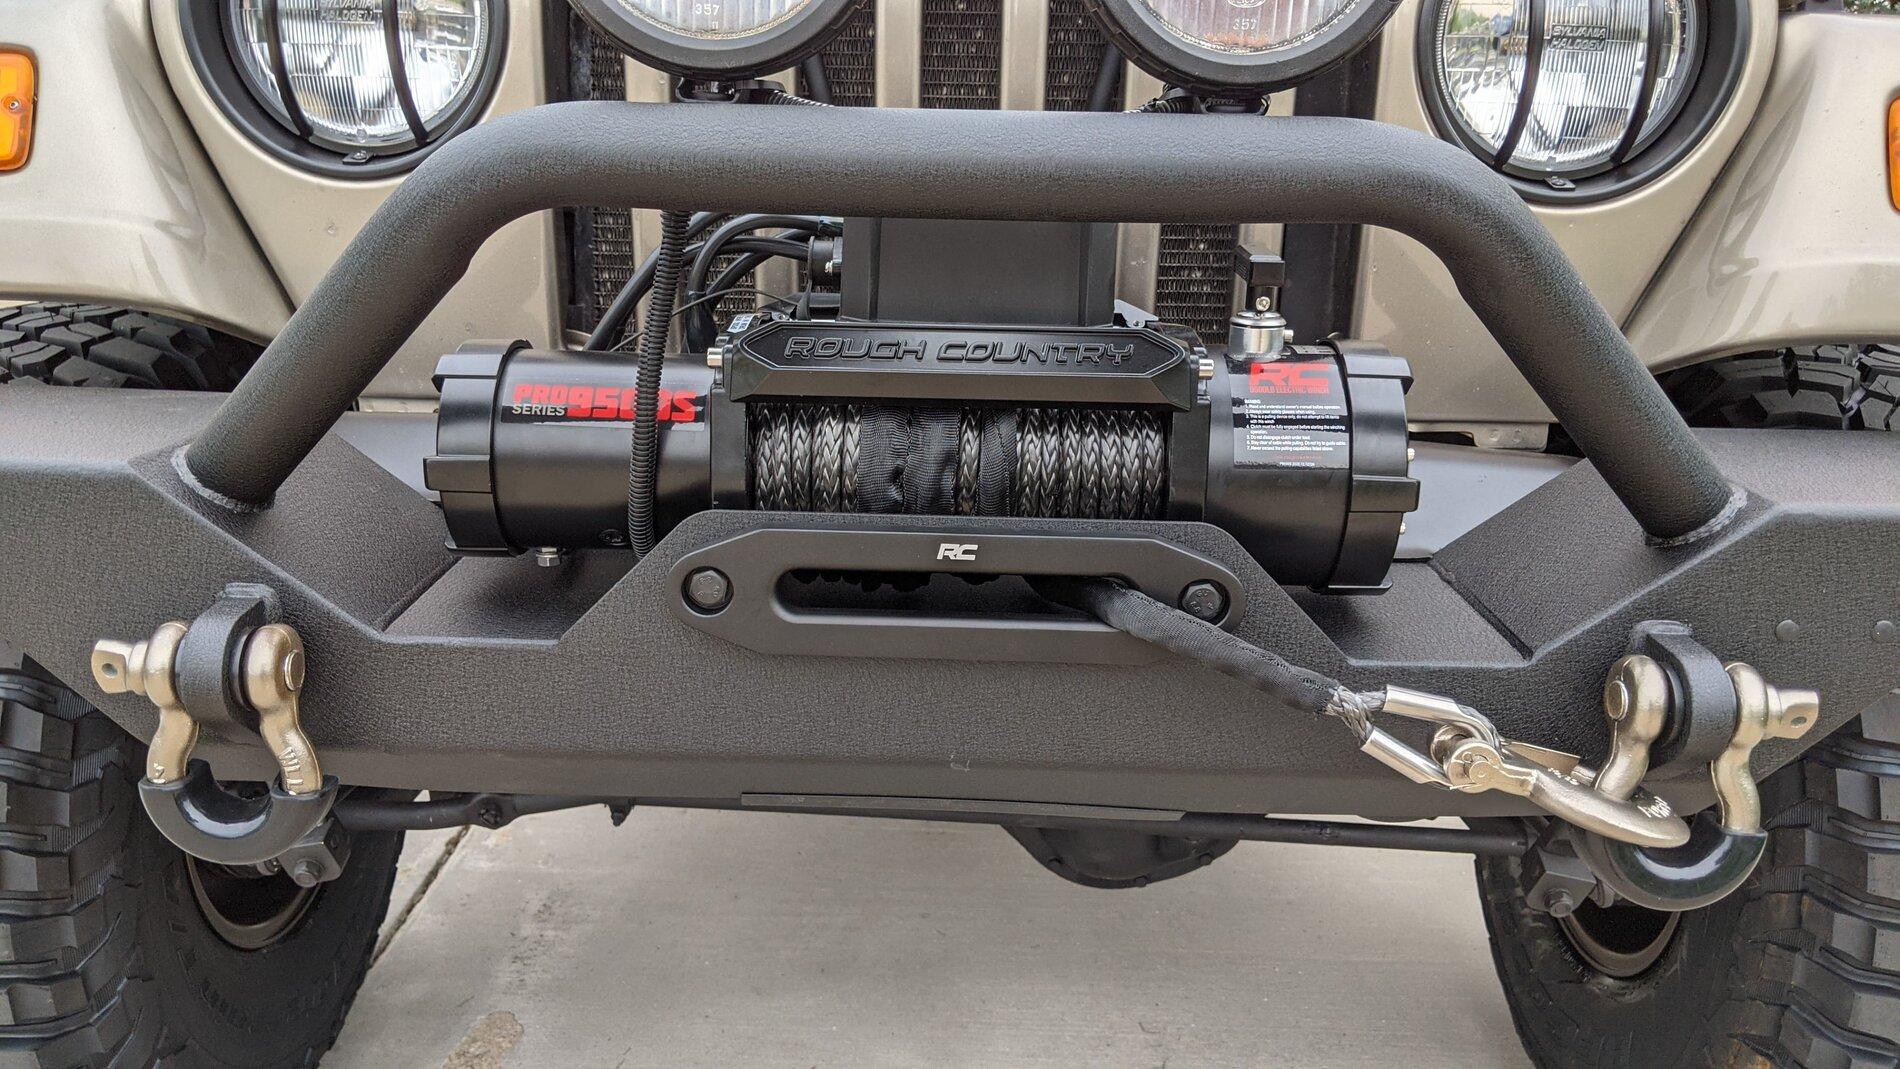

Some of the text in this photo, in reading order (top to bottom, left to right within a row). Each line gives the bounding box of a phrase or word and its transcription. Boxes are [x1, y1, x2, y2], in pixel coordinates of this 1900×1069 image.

[695, 3, 720, 16] 357
[1552, 25, 1606, 38] SYLVANIA
[1550, 38, 1604, 51] HALOGEN
[784, 336, 1134, 366] ROUGH COUNTRY
[1250, 362, 1329, 386] RC
[513, 384, 567, 405] PRO
[512, 403, 566, 416] SERIES
[937, 543, 978, 561] RC
